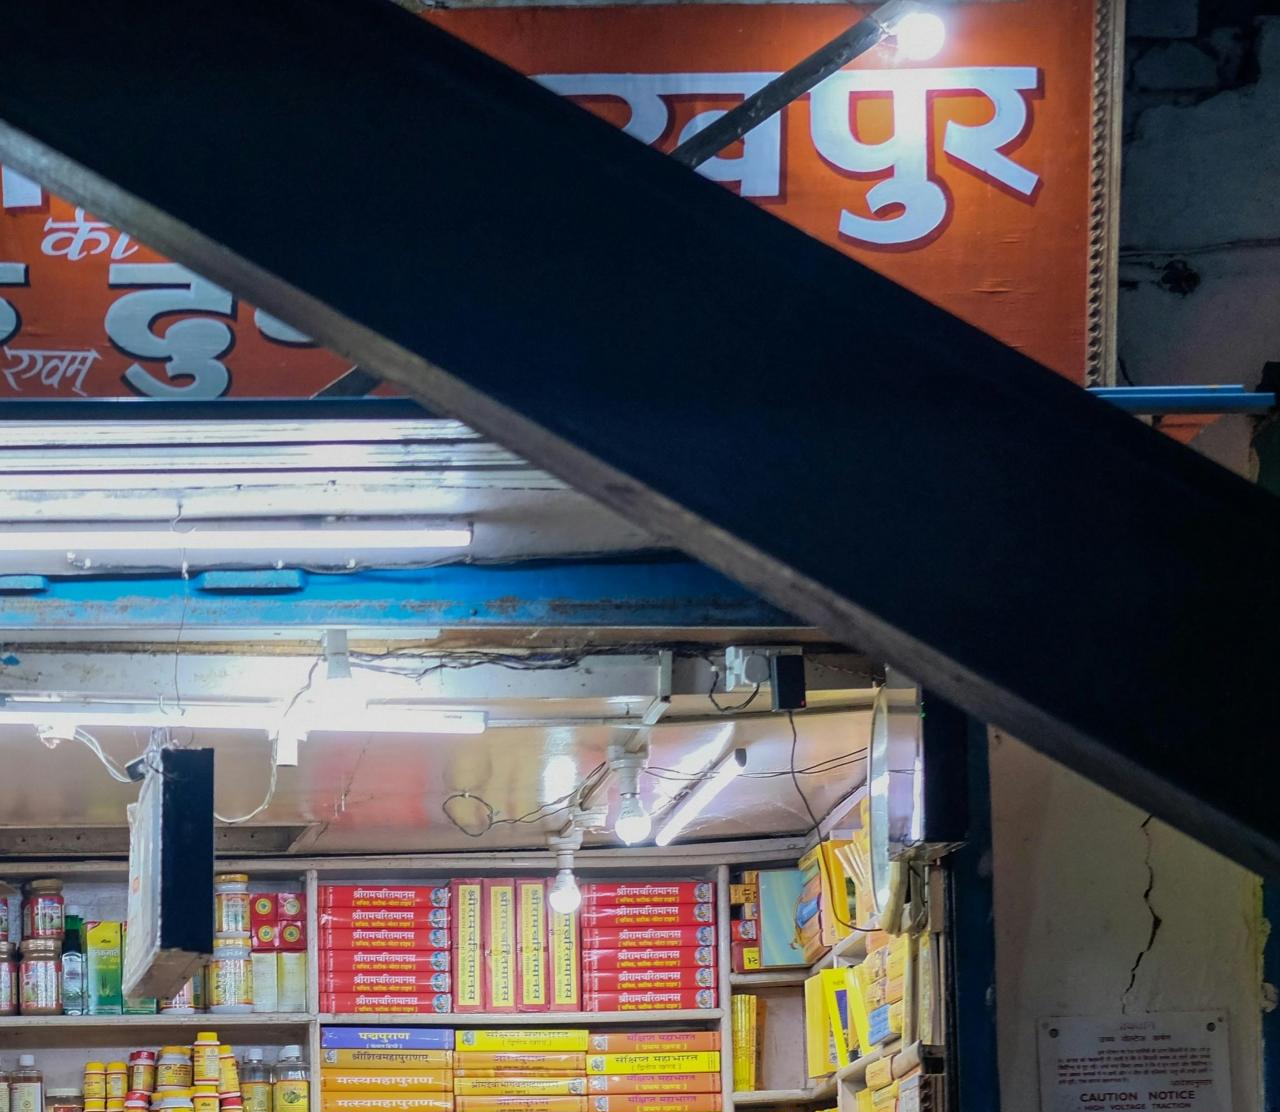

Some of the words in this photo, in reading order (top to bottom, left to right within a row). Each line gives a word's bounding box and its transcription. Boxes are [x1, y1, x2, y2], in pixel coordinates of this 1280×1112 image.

[1079, 1092, 1138, 1103] CAUTION
[1148, 1090, 1196, 1100] NOTICE
[1152, 1102, 1192, 1110] TRACTION
